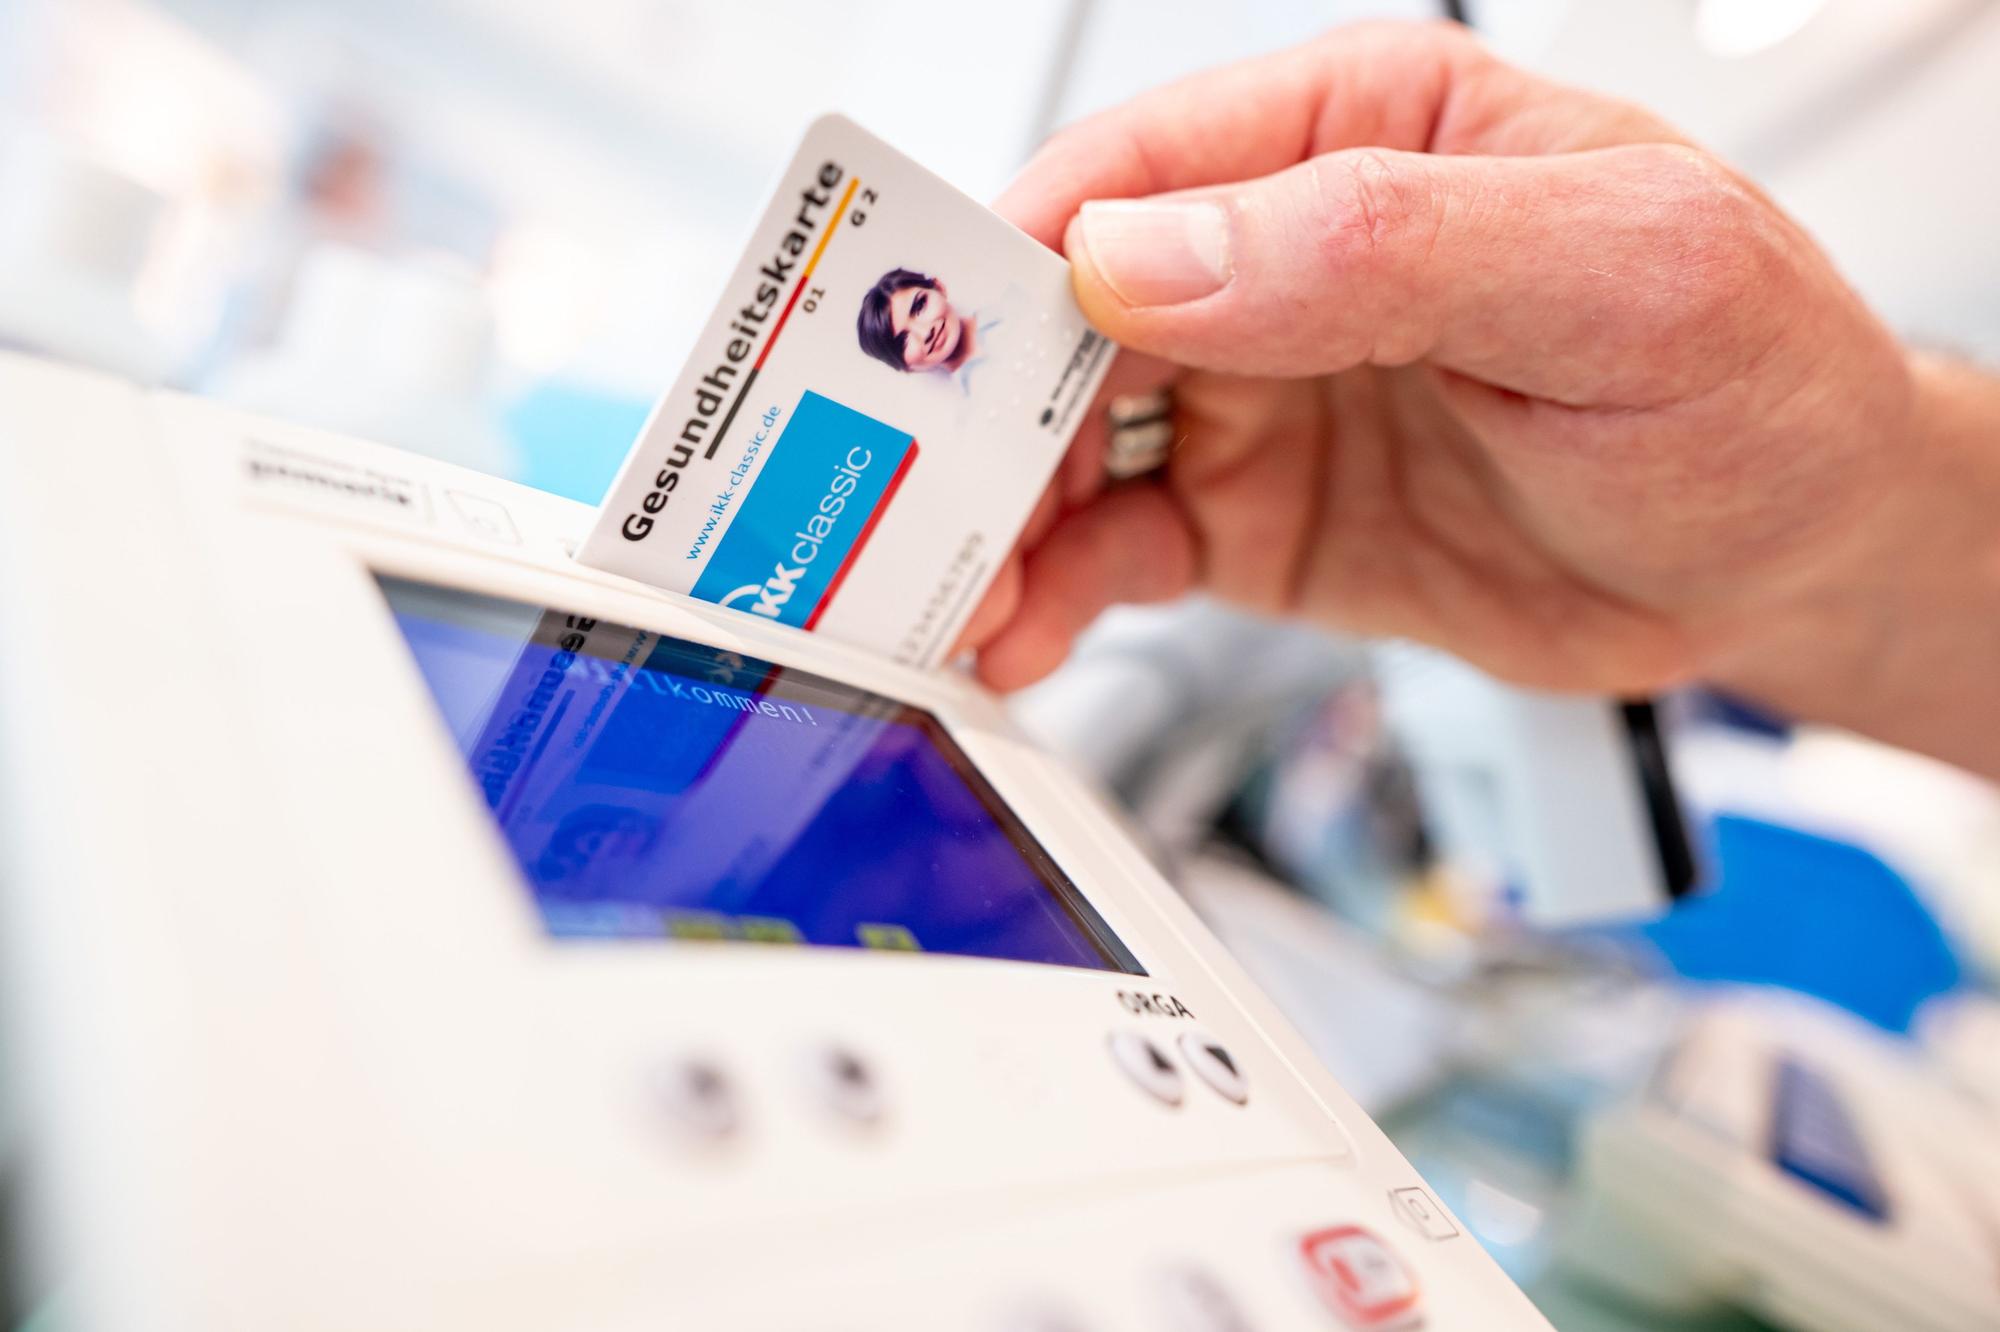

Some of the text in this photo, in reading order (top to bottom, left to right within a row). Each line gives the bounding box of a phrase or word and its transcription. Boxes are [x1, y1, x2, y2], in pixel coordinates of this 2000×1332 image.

[850, 187, 879, 228] G 2
[621, 160, 844, 543] Gesundheitskarte
[686, 404, 782, 561] www.ikk-classic.de
[750, 561, 808, 619] KK
[1116, 990, 1197, 1019] ORGA
